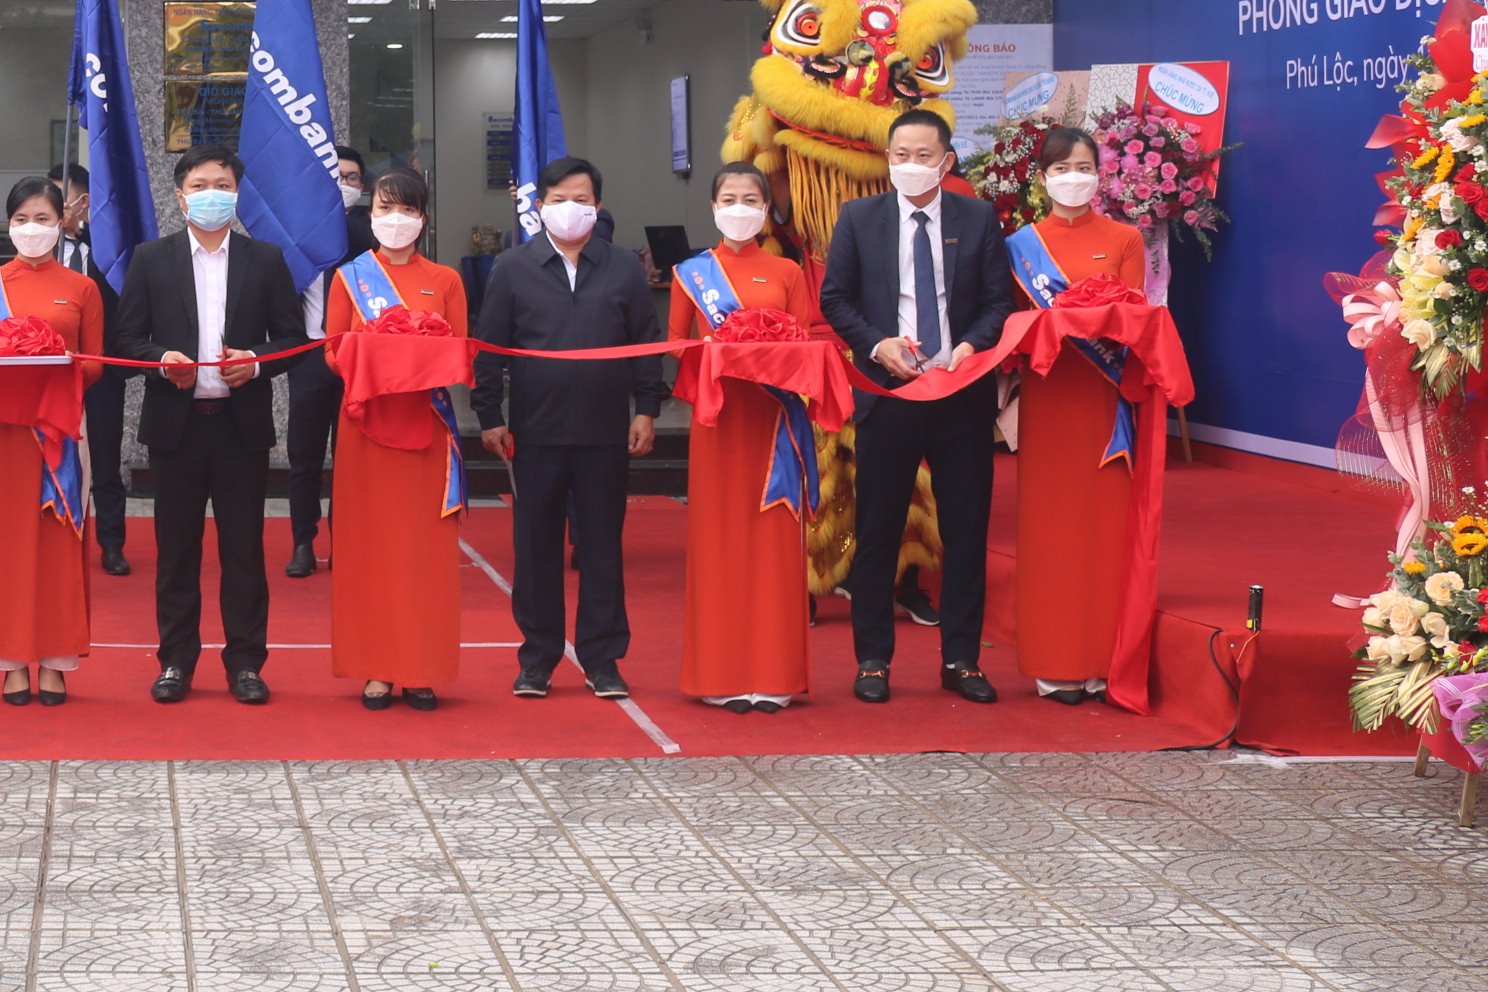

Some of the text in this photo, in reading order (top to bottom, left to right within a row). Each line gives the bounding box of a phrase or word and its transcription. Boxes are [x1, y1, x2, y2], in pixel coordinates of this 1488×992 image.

[968, 42, 1016, 53] ÔNG BÁO
[1286, 49, 1318, 90] Phú
[1323, 51, 1358, 91] Lộc,
[1363, 44, 1410, 89] ngày
[1154, 81, 1178, 100] CHÚC
